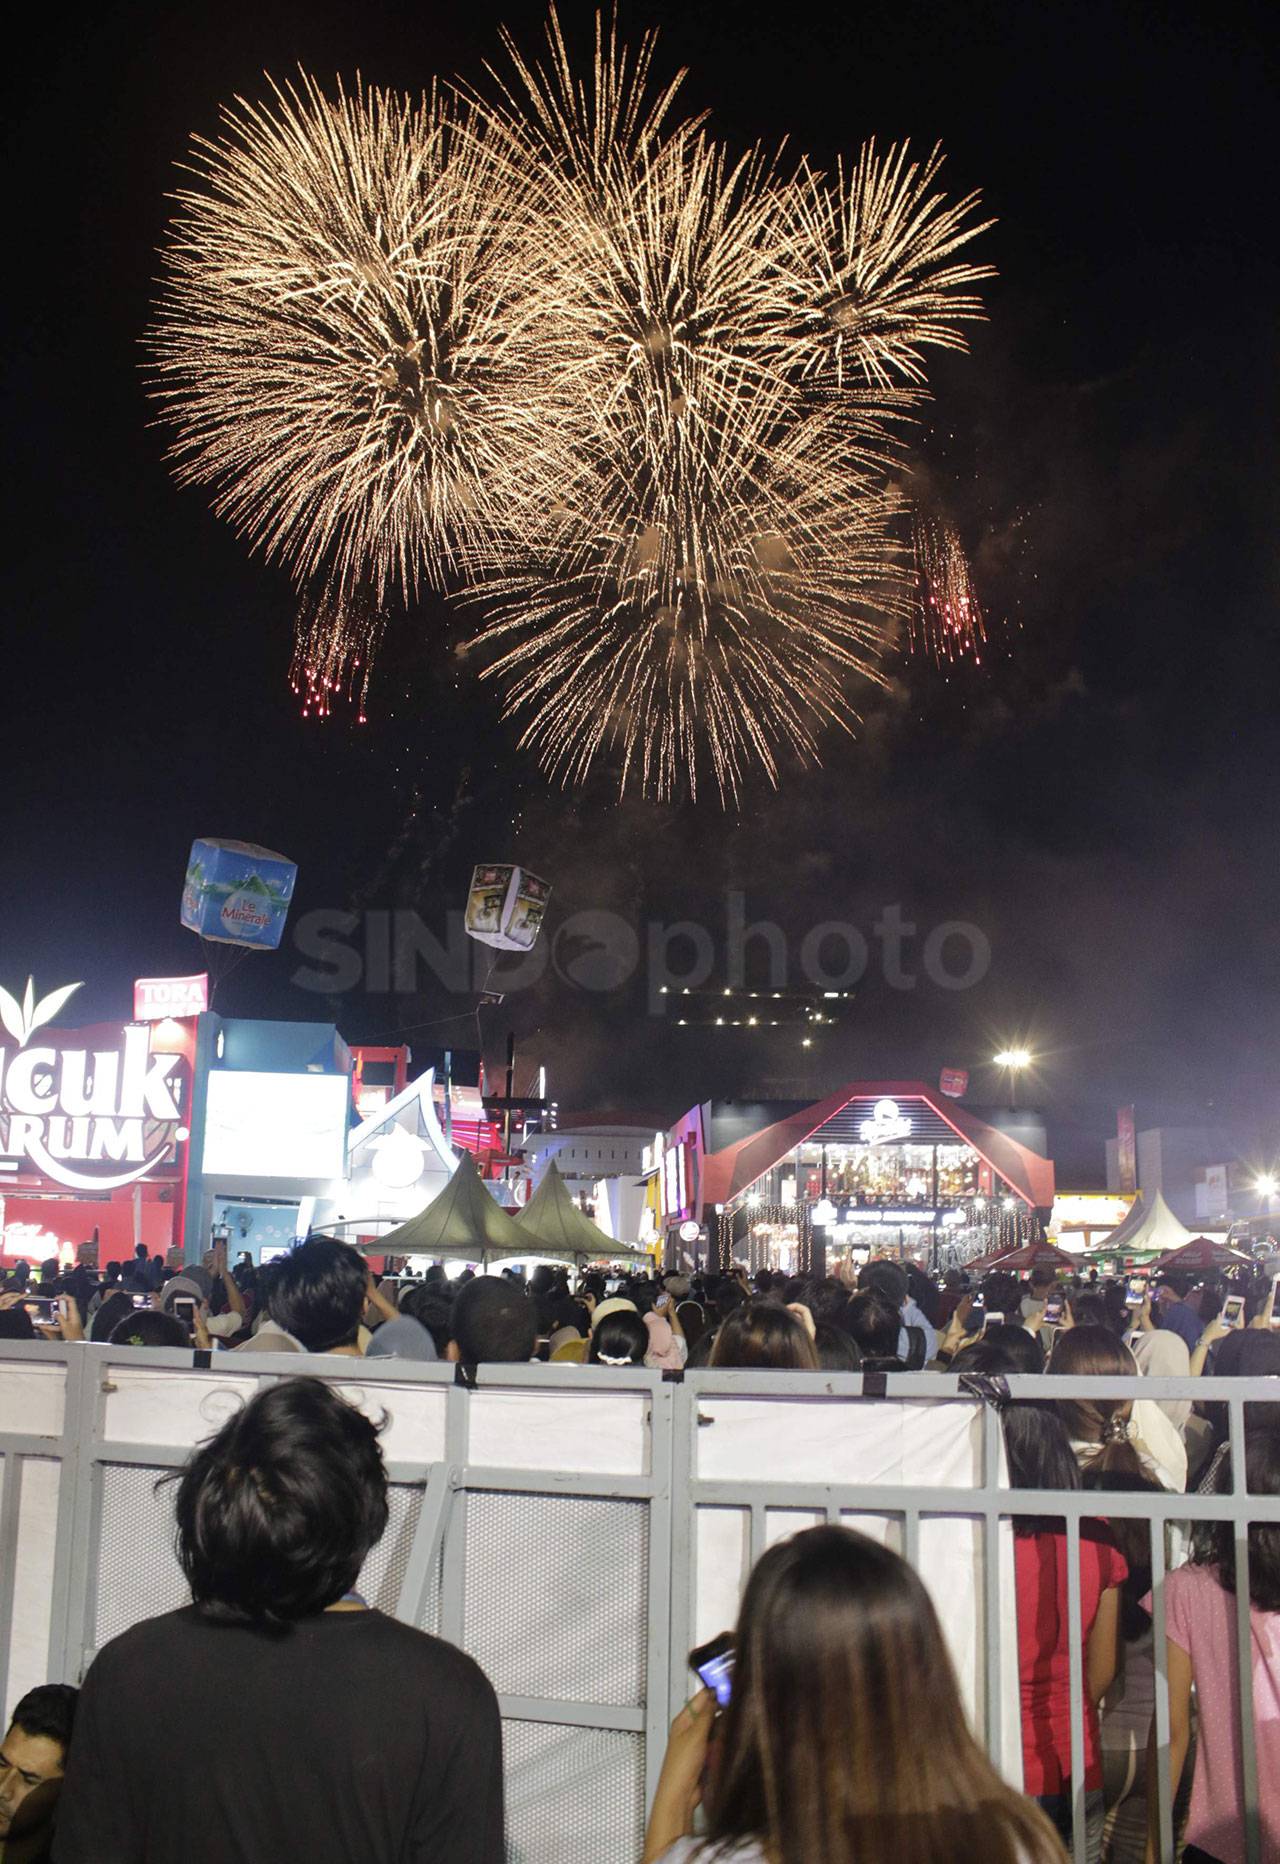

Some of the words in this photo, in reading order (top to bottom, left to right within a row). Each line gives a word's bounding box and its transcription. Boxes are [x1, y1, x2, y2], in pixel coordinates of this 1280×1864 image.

[242, 899, 256, 913] Le
[139, 983, 204, 1003] TORA
[0, 1025, 181, 1119] cuk
